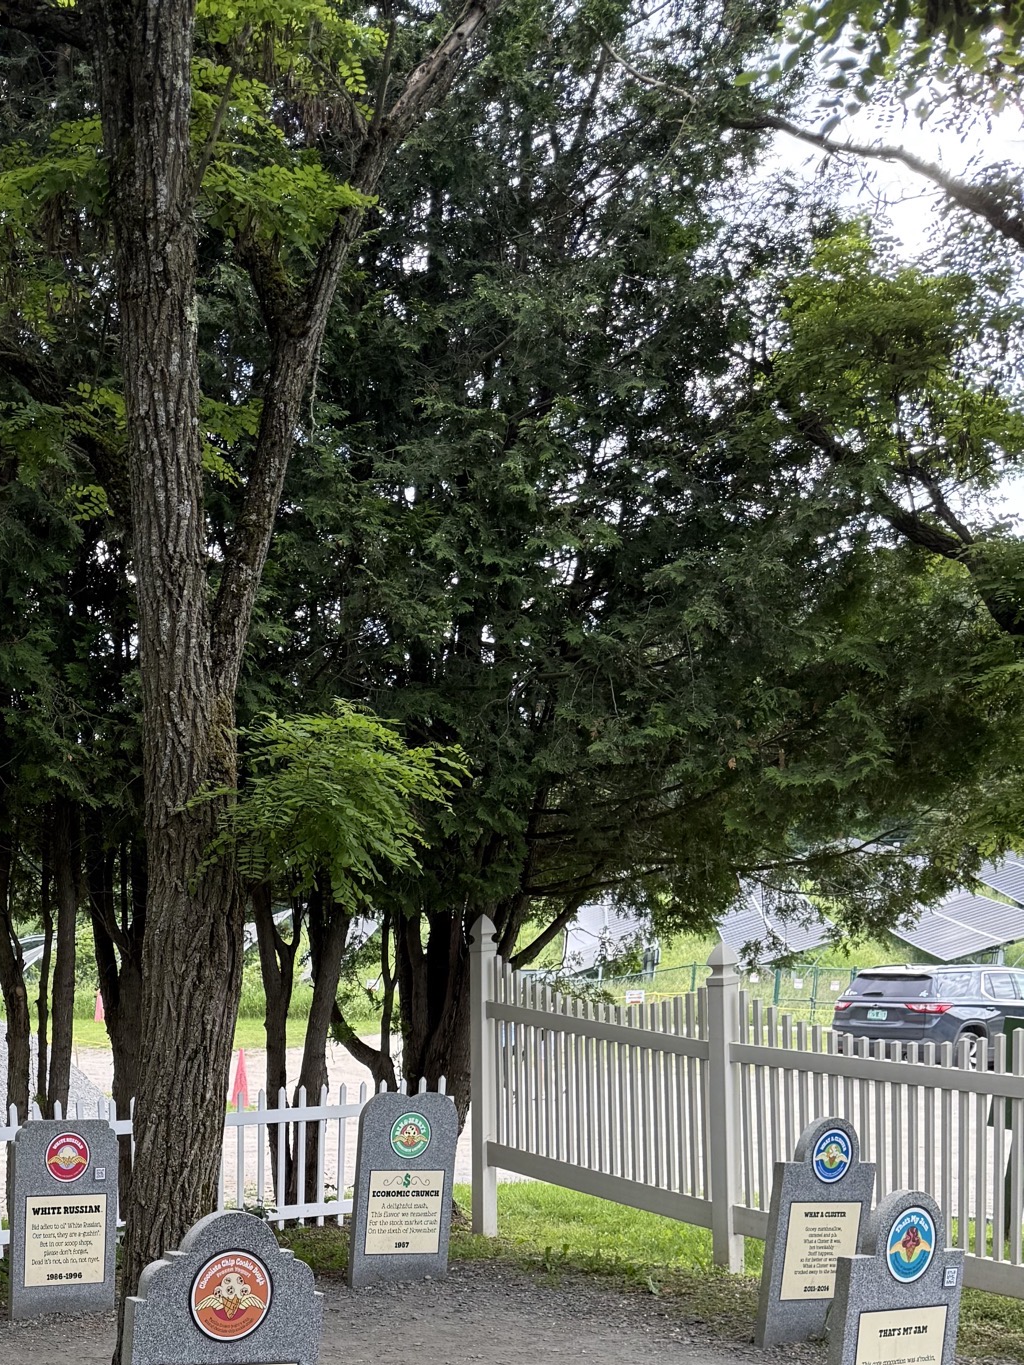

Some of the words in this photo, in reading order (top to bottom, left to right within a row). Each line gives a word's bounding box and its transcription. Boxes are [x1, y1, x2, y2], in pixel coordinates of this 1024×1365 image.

[53, 1138, 66, 1150] WHITE
[66, 1137, 84, 1150] RUSSIAN
[32, 1206, 62, 1215] WHITE
[64, 1205, 101, 1215] RUSSIAN
[896, 1217, 910, 1233] That's
[911, 1215, 919, 1224] My
[919, 1217, 929, 1232] Jam
[47, 1272, 82, 1281] 1986-1996
[199, 1263, 221, 1289] Chocolate
[236, 1258, 254, 1269] Cookie
[252, 1267, 265, 1286] Dough
[879, 1328, 901, 1338] THAT'S
[902, 1327, 913, 1335] MY
[914, 1325, 928, 1334] JAM
